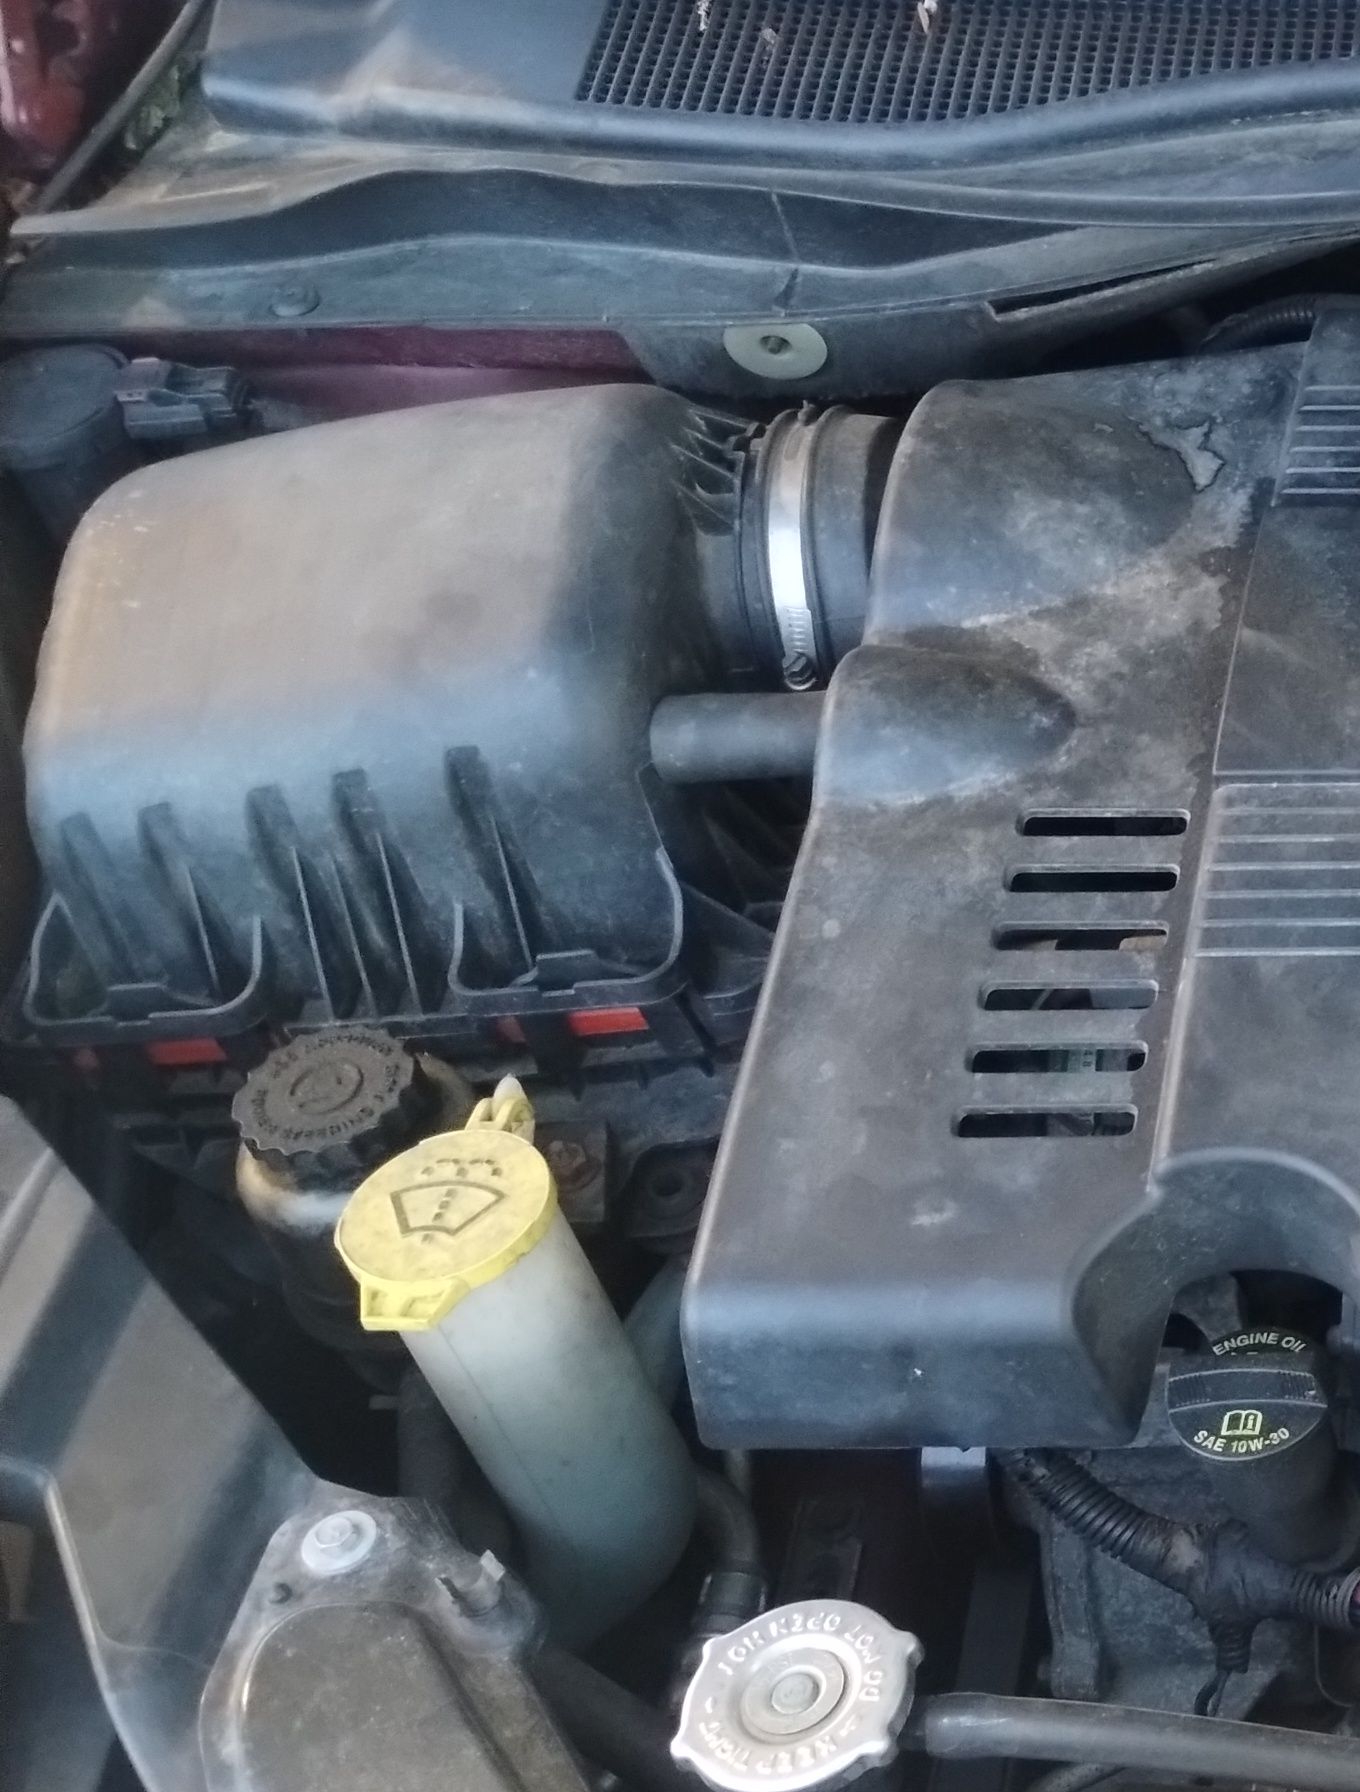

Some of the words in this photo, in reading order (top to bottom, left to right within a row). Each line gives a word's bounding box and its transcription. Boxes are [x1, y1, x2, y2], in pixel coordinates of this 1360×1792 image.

[1212, 1332, 1281, 1356] ENGINE
[1281, 1336, 1307, 1353] OIL
[1193, 1430, 1227, 1452] SAE
[1231, 1427, 1290, 1454] 10W-30
